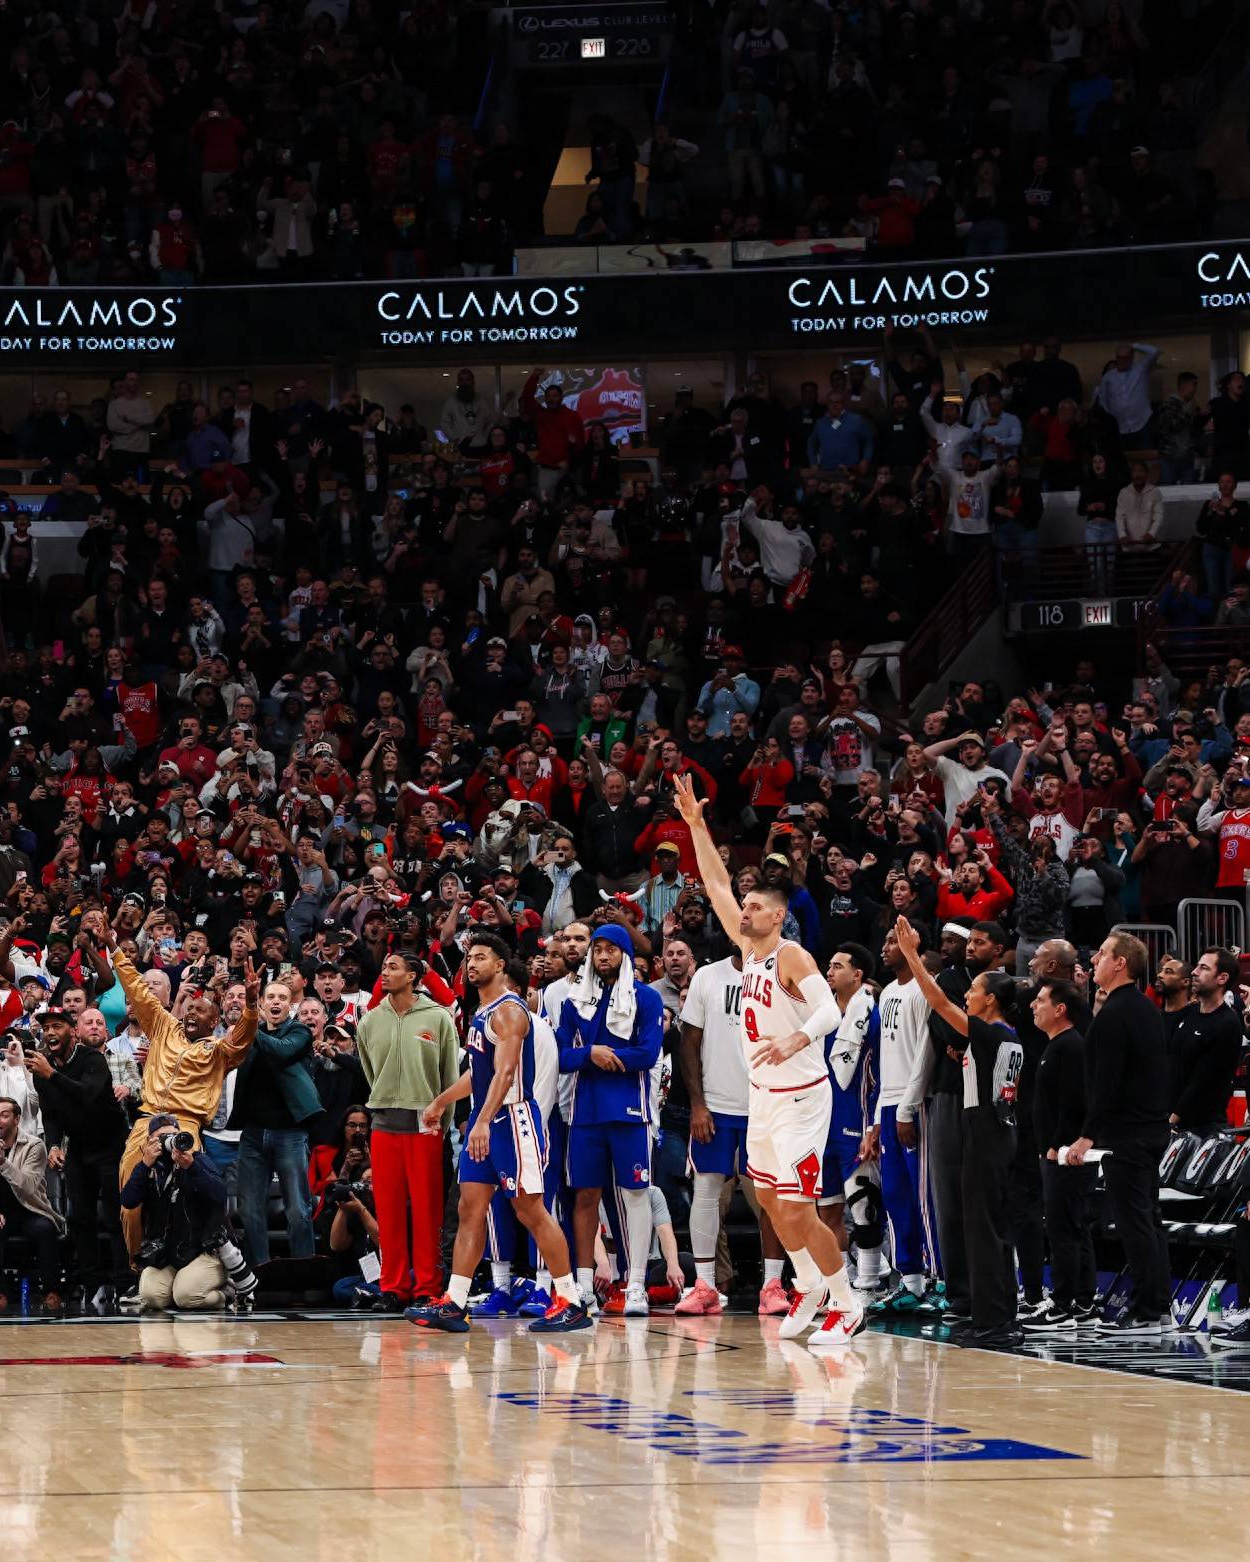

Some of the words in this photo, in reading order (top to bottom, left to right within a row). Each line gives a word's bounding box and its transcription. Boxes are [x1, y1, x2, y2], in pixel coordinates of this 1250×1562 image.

[583, 41, 604, 56] EXIT
[788, 270, 990, 307] CALAMOS
[377, 287, 580, 321] CALAMOS
[792, 317, 846, 332] TODAY
[854, 315, 886, 330] FOR
[40, 336, 72, 350] FOR
[77, 336, 176, 350] TOMORROW
[381, 330, 435, 344] TODAY
[442, 328, 473, 343] FOR
[479, 326, 578, 342] TOMORROW
[1038, 604, 1065, 626] 118
[1085, 605, 1109, 623] EXIT
[1224, 841, 1239, 859] 3
[744, 1007, 760, 1043] 9
